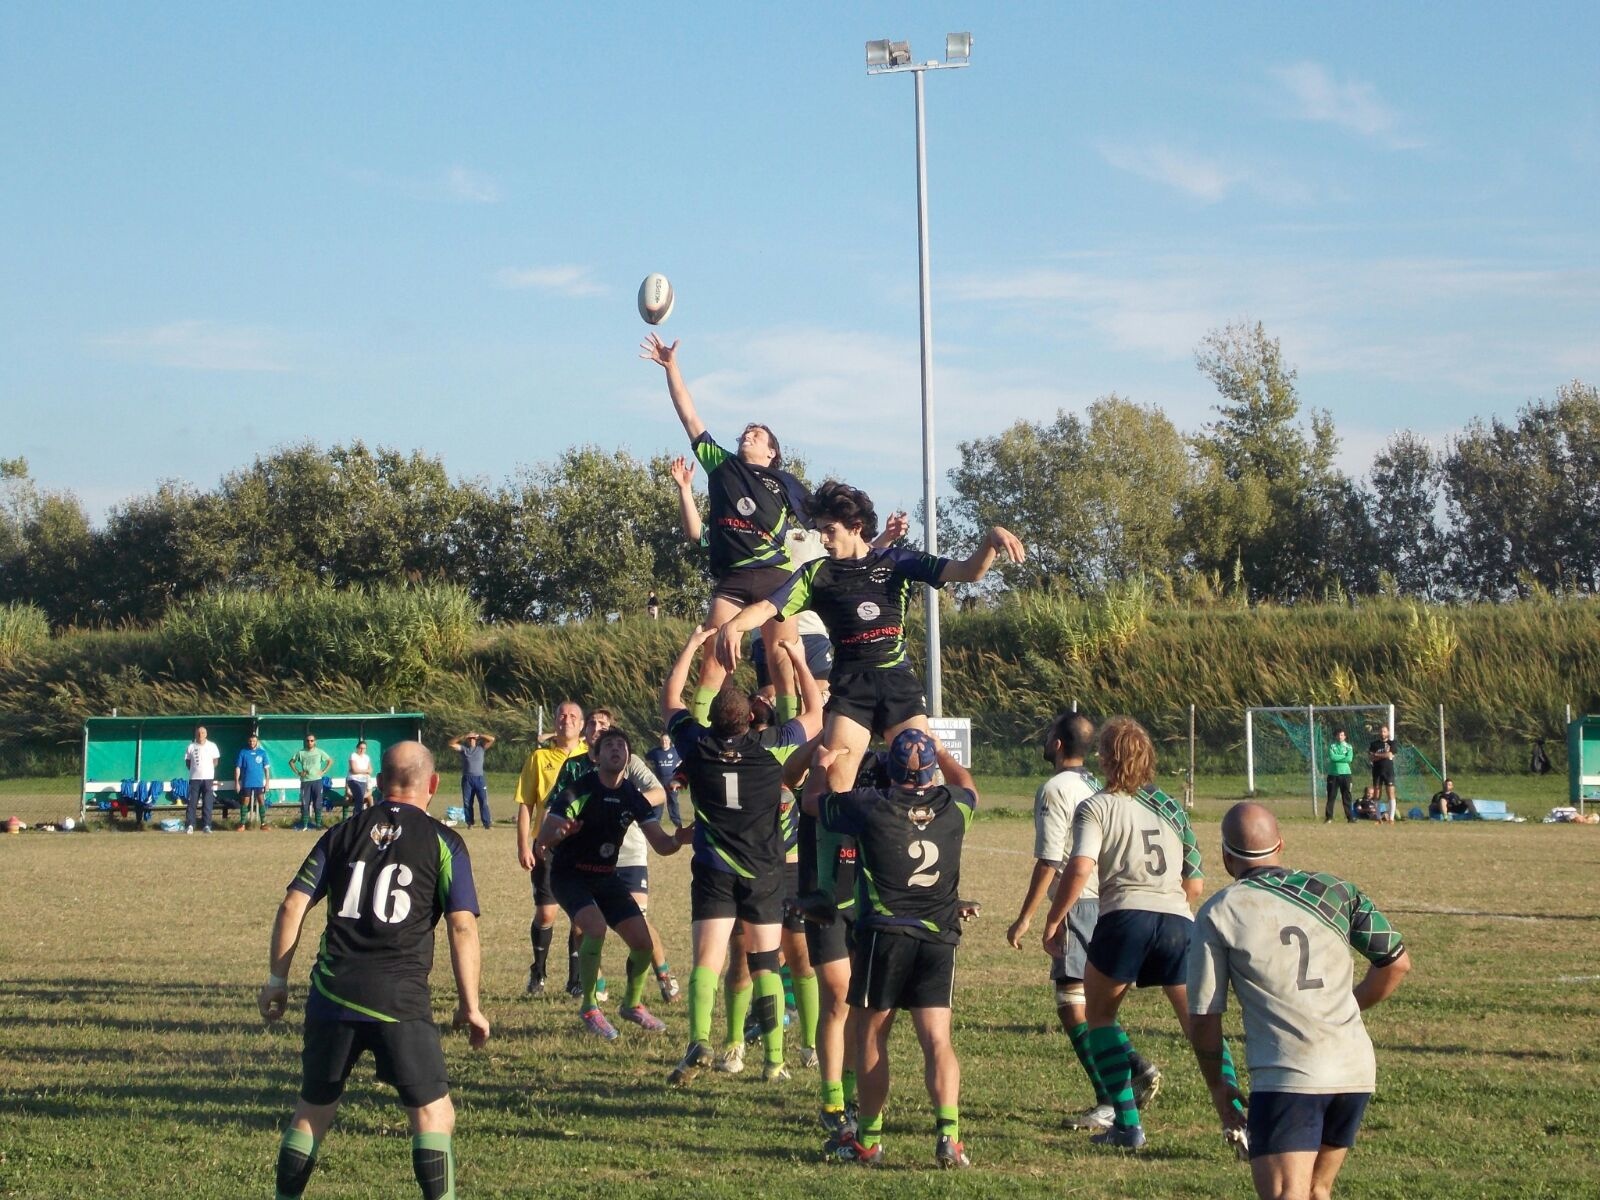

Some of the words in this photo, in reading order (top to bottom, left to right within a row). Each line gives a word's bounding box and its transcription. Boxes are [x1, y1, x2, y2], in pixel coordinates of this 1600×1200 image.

[722, 772, 742, 810] 1
[907, 840, 940, 887] 2
[1141, 829, 1167, 876] 5
[337, 860, 413, 924] 16
[1279, 925, 1325, 991] 2
